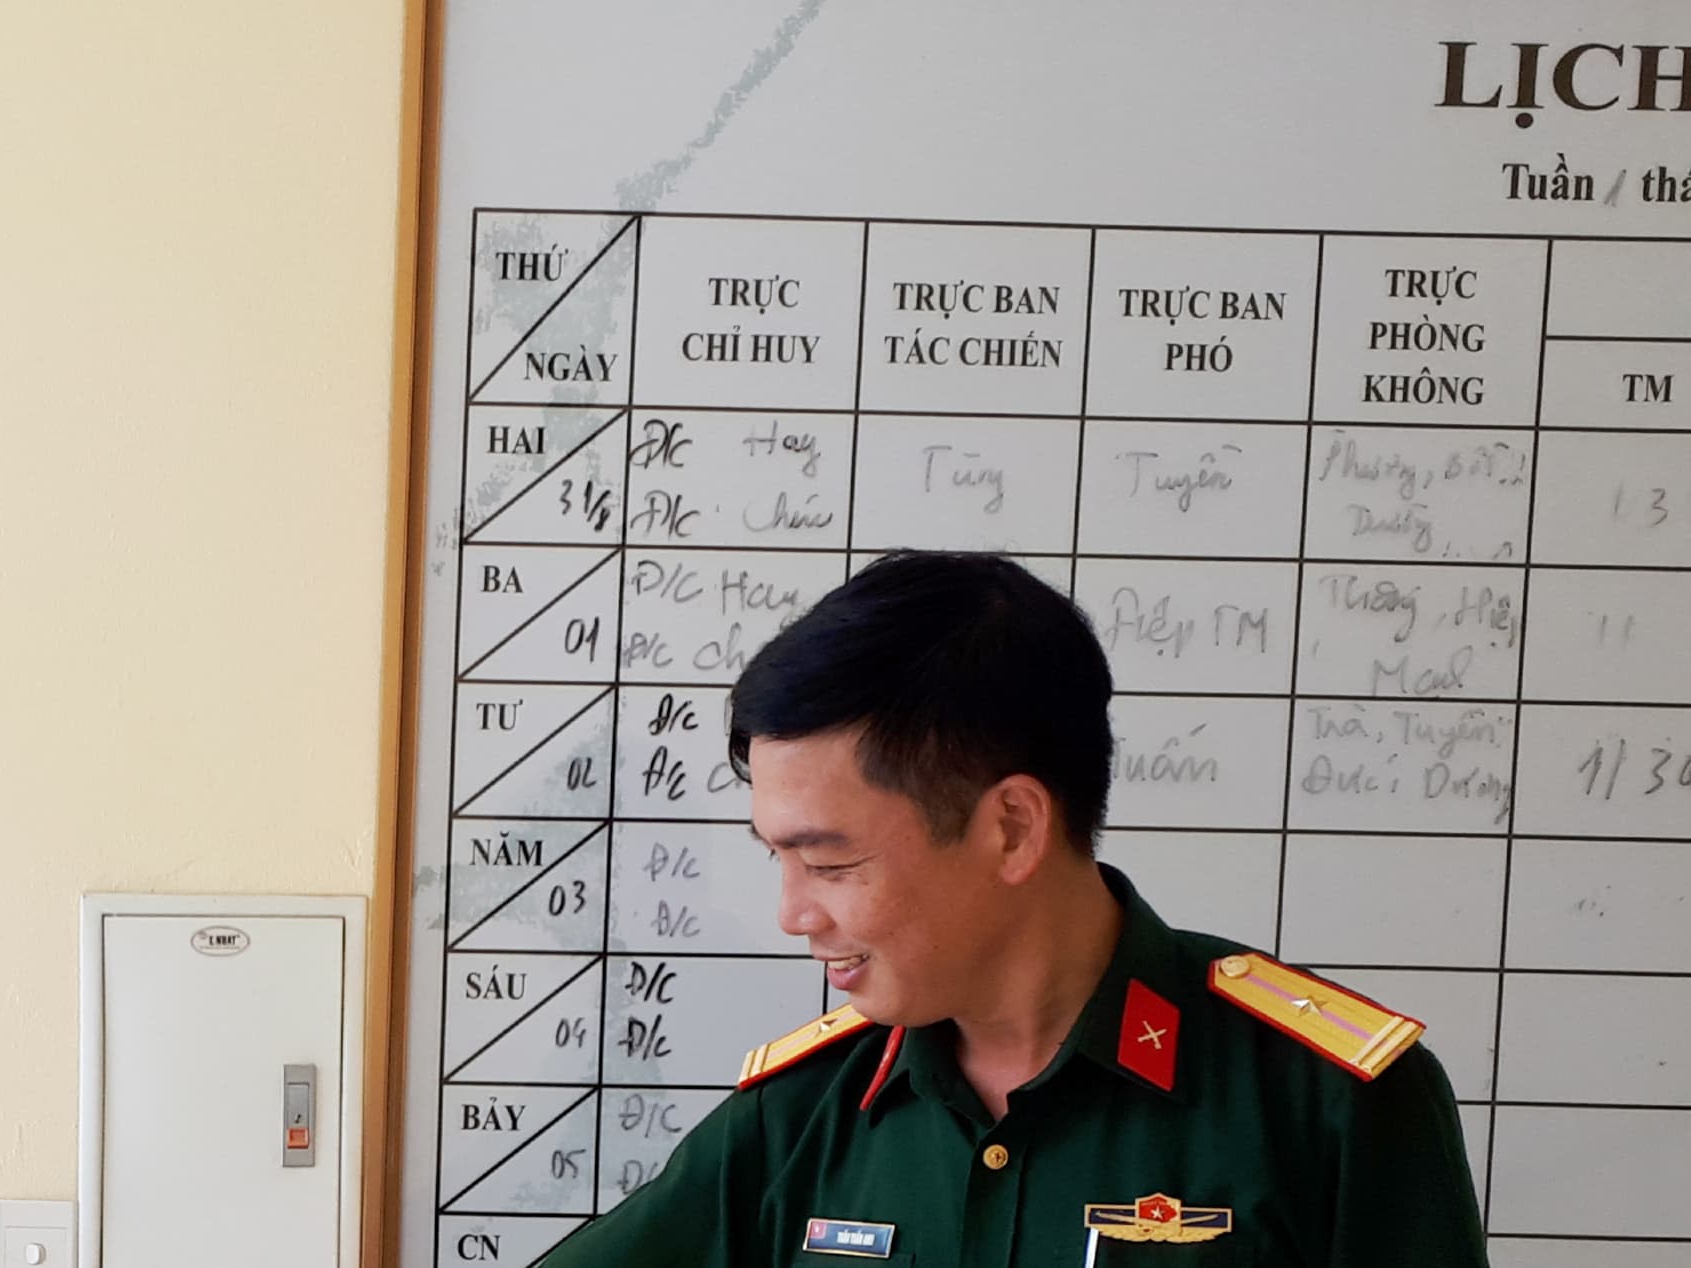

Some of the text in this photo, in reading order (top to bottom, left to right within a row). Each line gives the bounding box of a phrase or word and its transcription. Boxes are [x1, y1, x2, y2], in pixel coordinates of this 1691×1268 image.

[1434, 40, 1691, 129] LỊCH
[1502, 152, 1595, 202] Tuần
[495, 245, 570, 284] THỨ
[709, 273, 800, 316] TRỰC
[893, 280, 1060, 322] TRỰC BAN
[1386, 266, 1478, 307] TRỰC
[1119, 287, 1287, 328] TRỰC BAN
[681, 323, 820, 366] CHỈ HUY
[884, 328, 1063, 369] TÁC CHIẾN
[1369, 315, 1486, 354] PHÒNG
[524, 344, 619, 383] NGÀY
[1165, 336, 1233, 373] PHÓ
[1362, 366, 1485, 406] KHÔNG
[1623, 374, 1674, 403] TM
[487, 425, 546, 456] HAI
[482, 565, 524, 594] BA
[564, 616, 601, 663] 01
[476, 699, 524, 731] TƯ
[567, 757, 598, 791] 02
[470, 830, 545, 868] NĂM
[548, 880, 587, 918] 03
[465, 965, 528, 1001] SÁU
[555, 1017, 588, 1049] 04
[460, 1096, 527, 1132] BẢY
[551, 1149, 588, 1180] 05
[457, 1233, 502, 1262] CN
